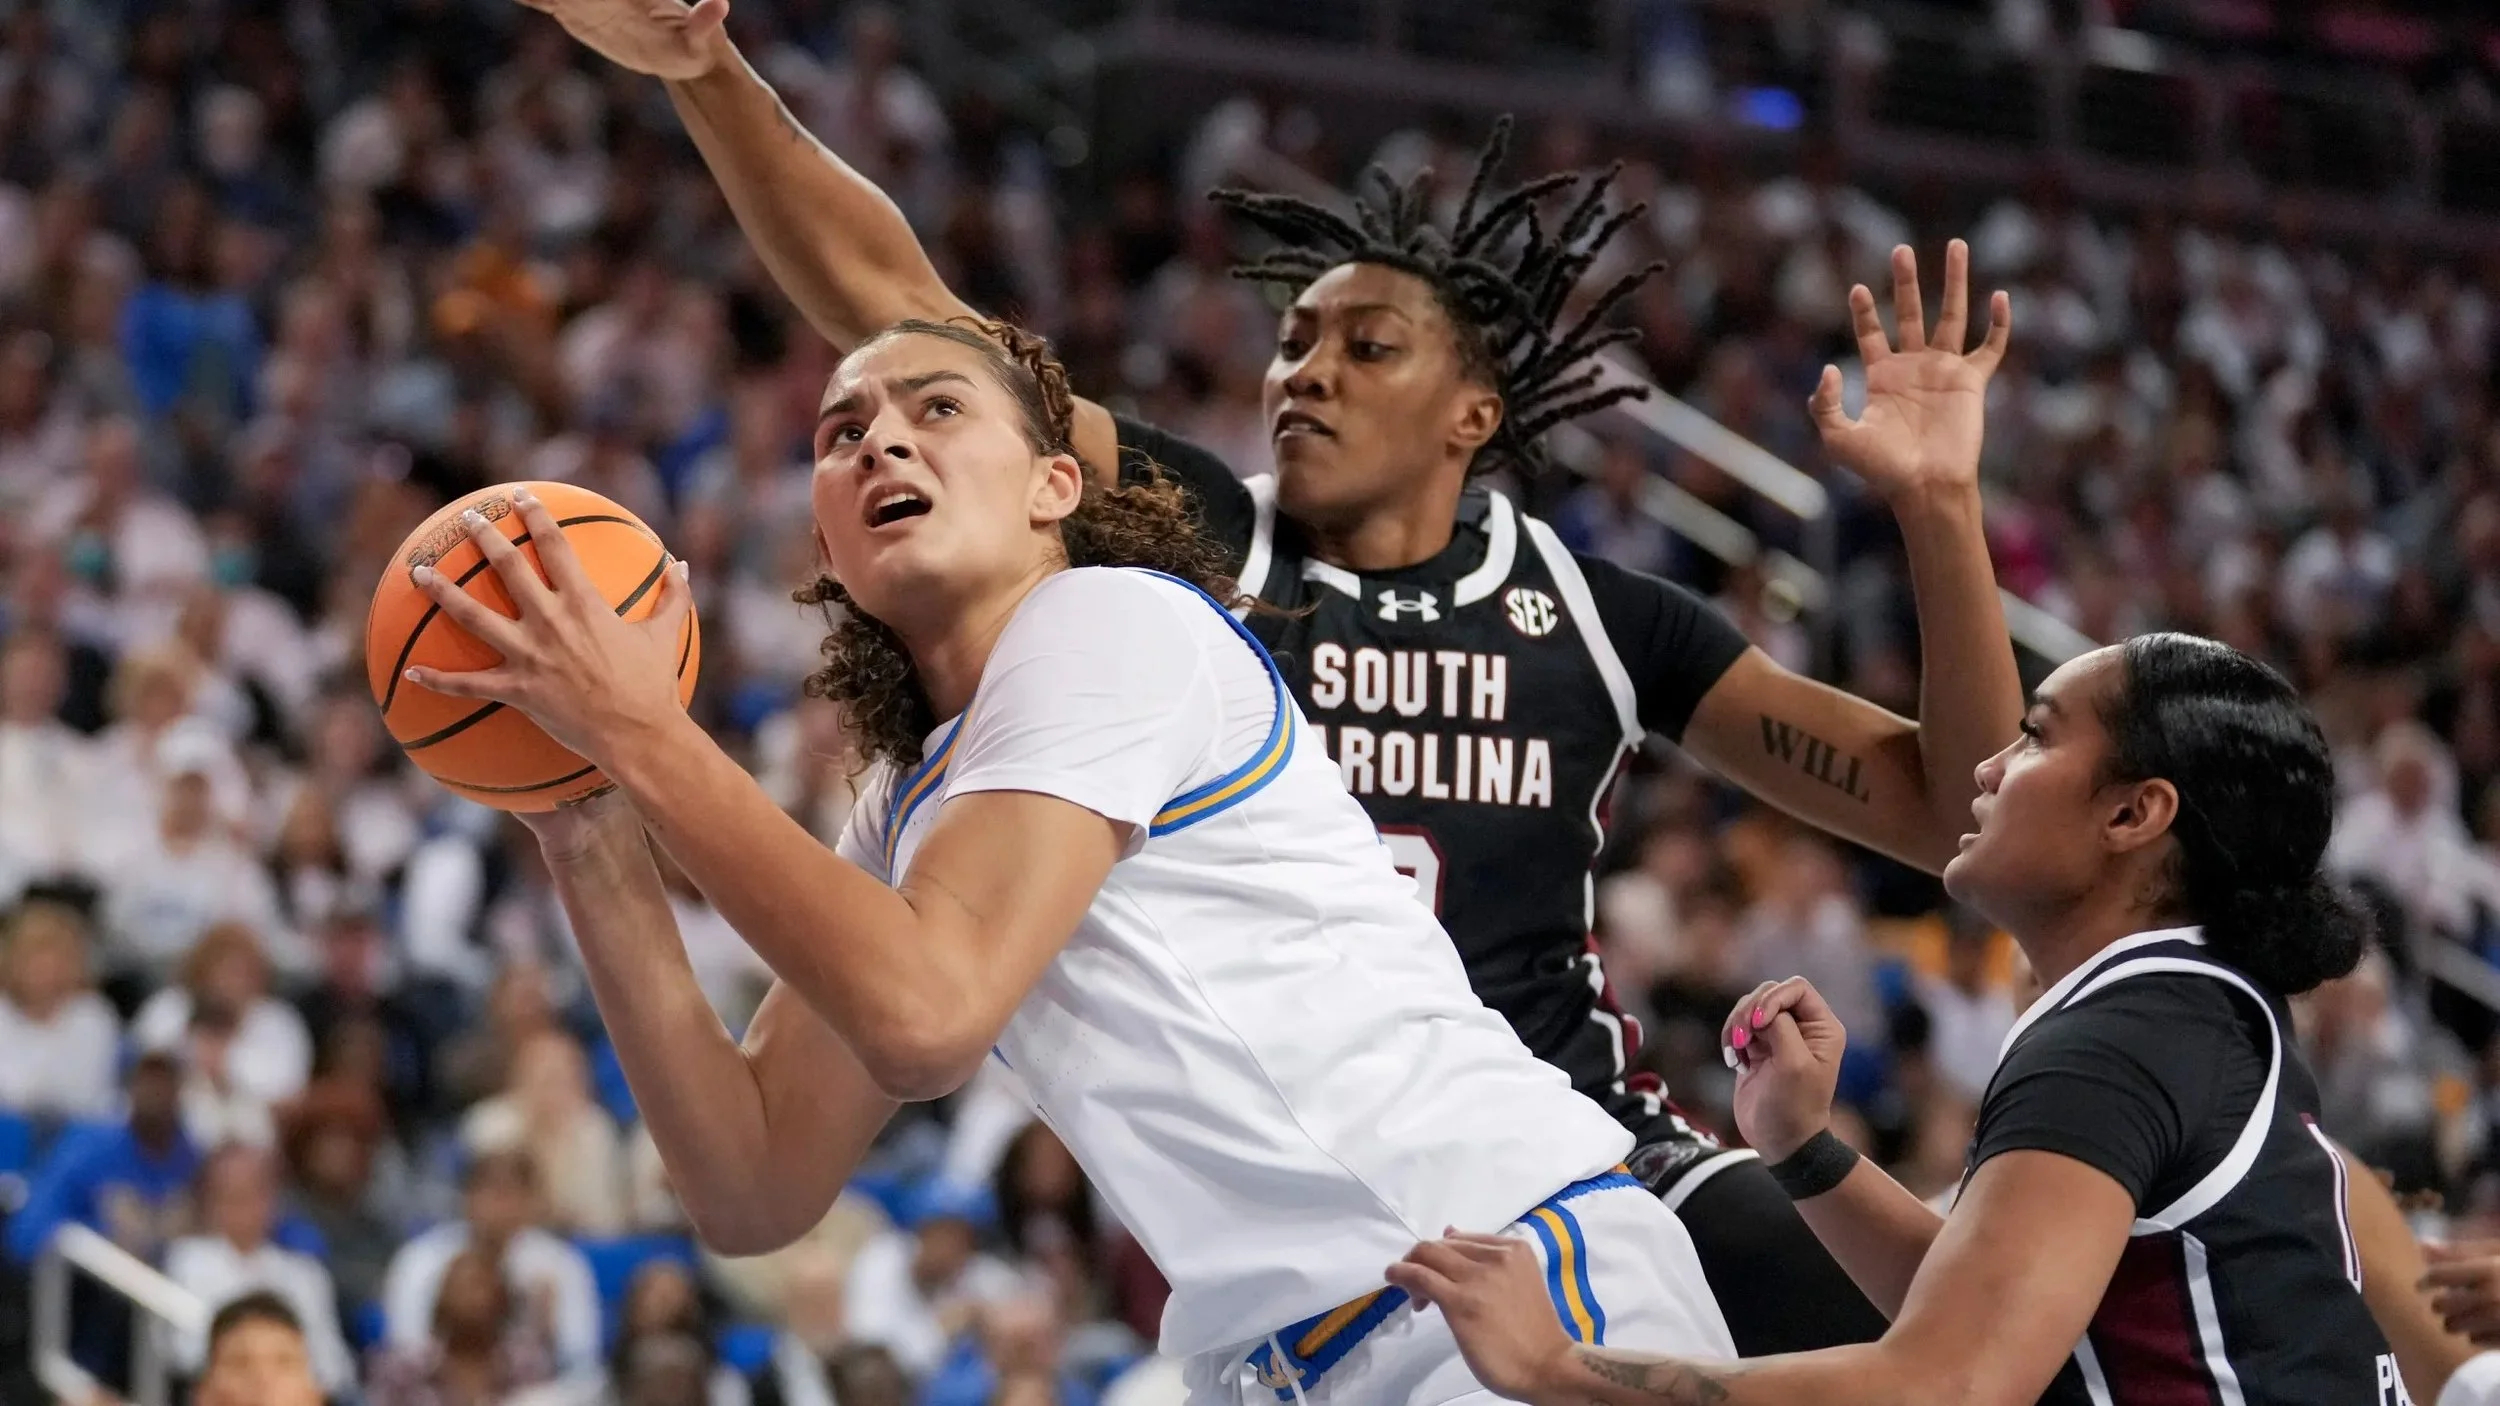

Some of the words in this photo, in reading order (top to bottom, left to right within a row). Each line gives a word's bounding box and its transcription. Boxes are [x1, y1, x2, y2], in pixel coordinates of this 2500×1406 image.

[1505, 587, 1559, 637] SEC
[1311, 642, 1507, 721] SOUTH
[1308, 723, 1552, 808] ROLINA
[1759, 713, 1870, 803] WILL
